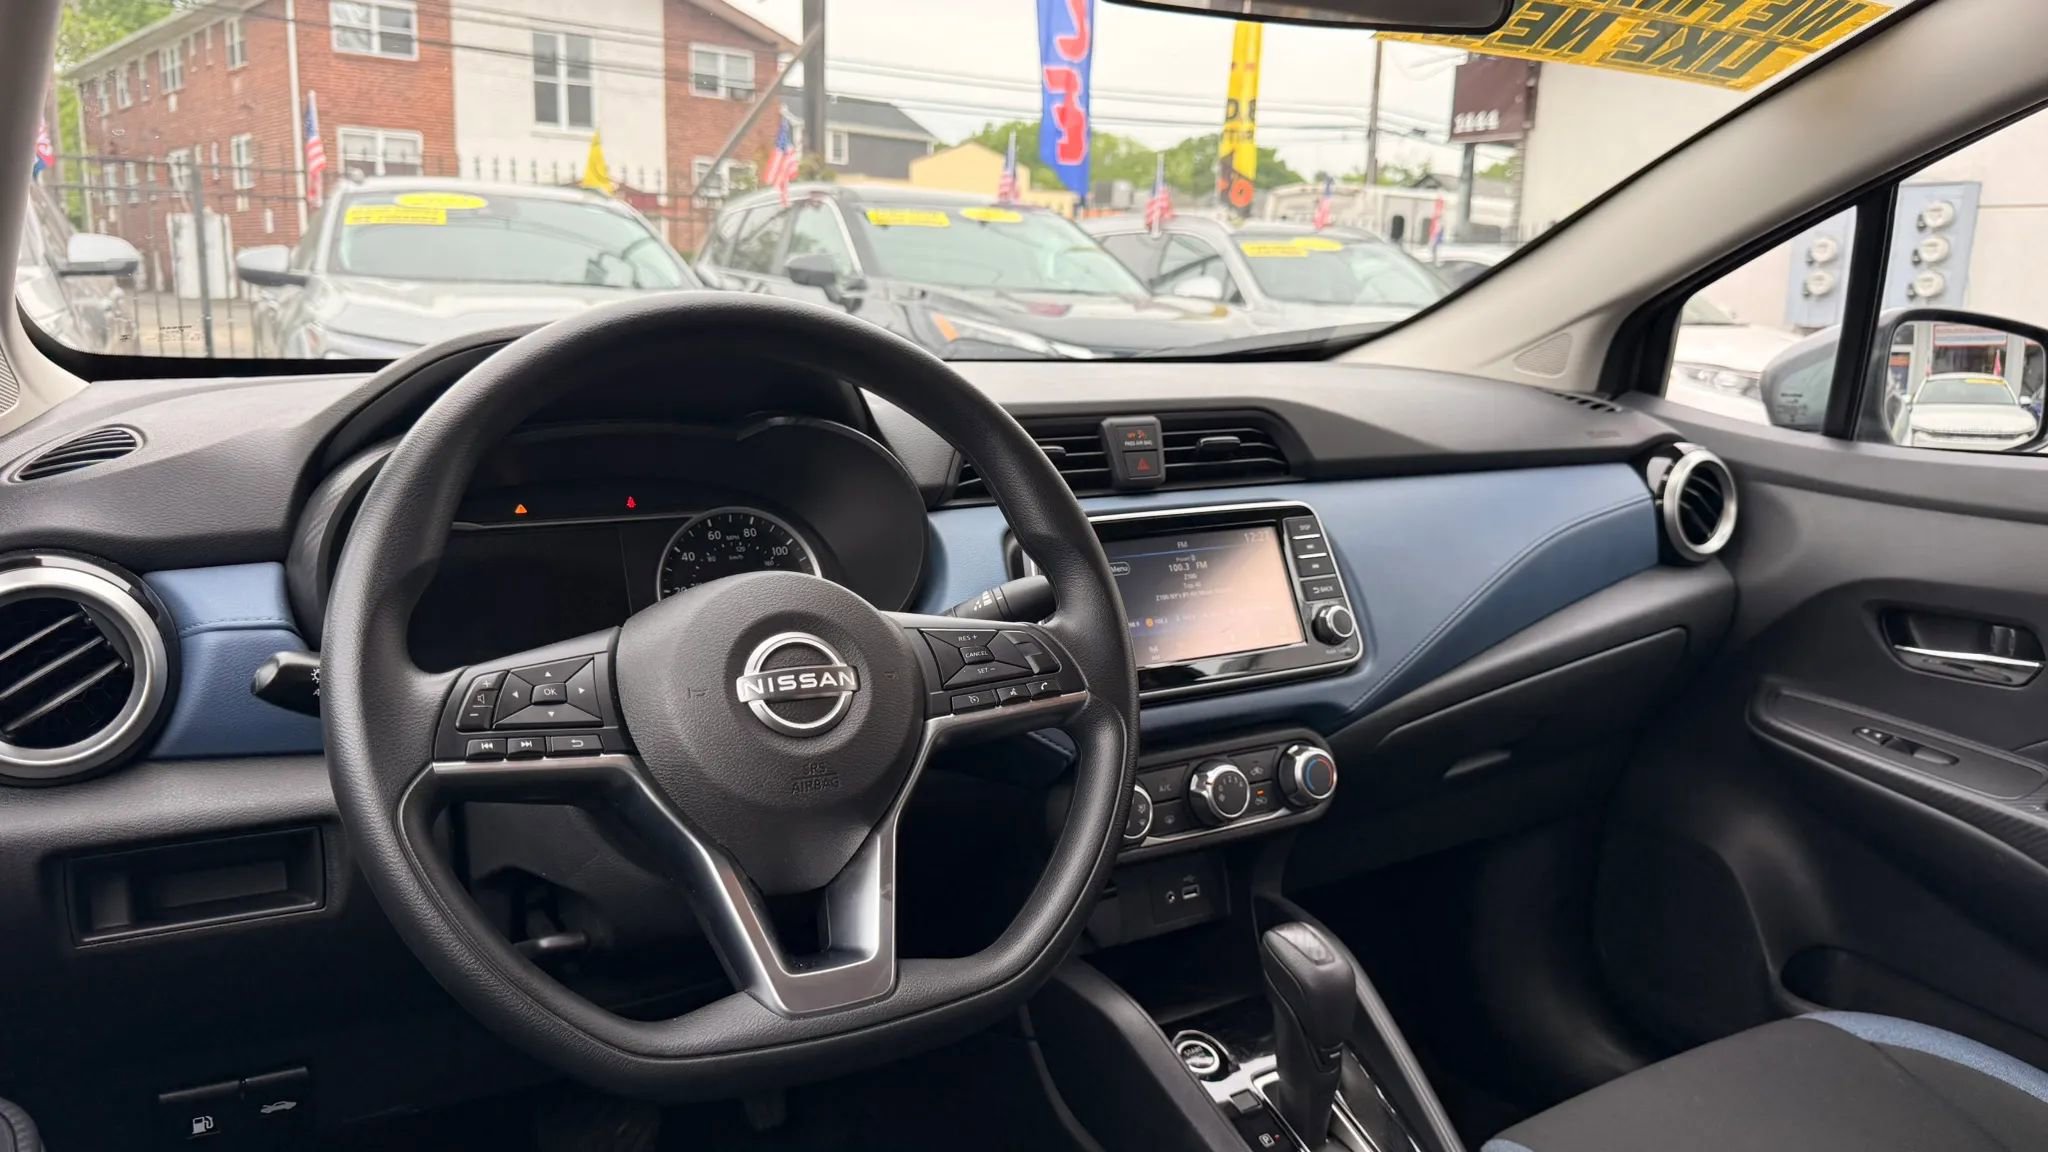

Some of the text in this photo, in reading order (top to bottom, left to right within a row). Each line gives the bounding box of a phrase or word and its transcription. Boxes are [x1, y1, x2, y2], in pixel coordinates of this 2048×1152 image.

[708, 530, 721, 540] 60
[744, 528, 757, 538] 80
[772, 546, 788, 556] 100
[682, 552, 696, 562] 40
[1168, 561, 1208, 572] 100.3 FM
[743, 671, 857, 695] NISSAN
[792, 777, 840, 794] AIRBAG
